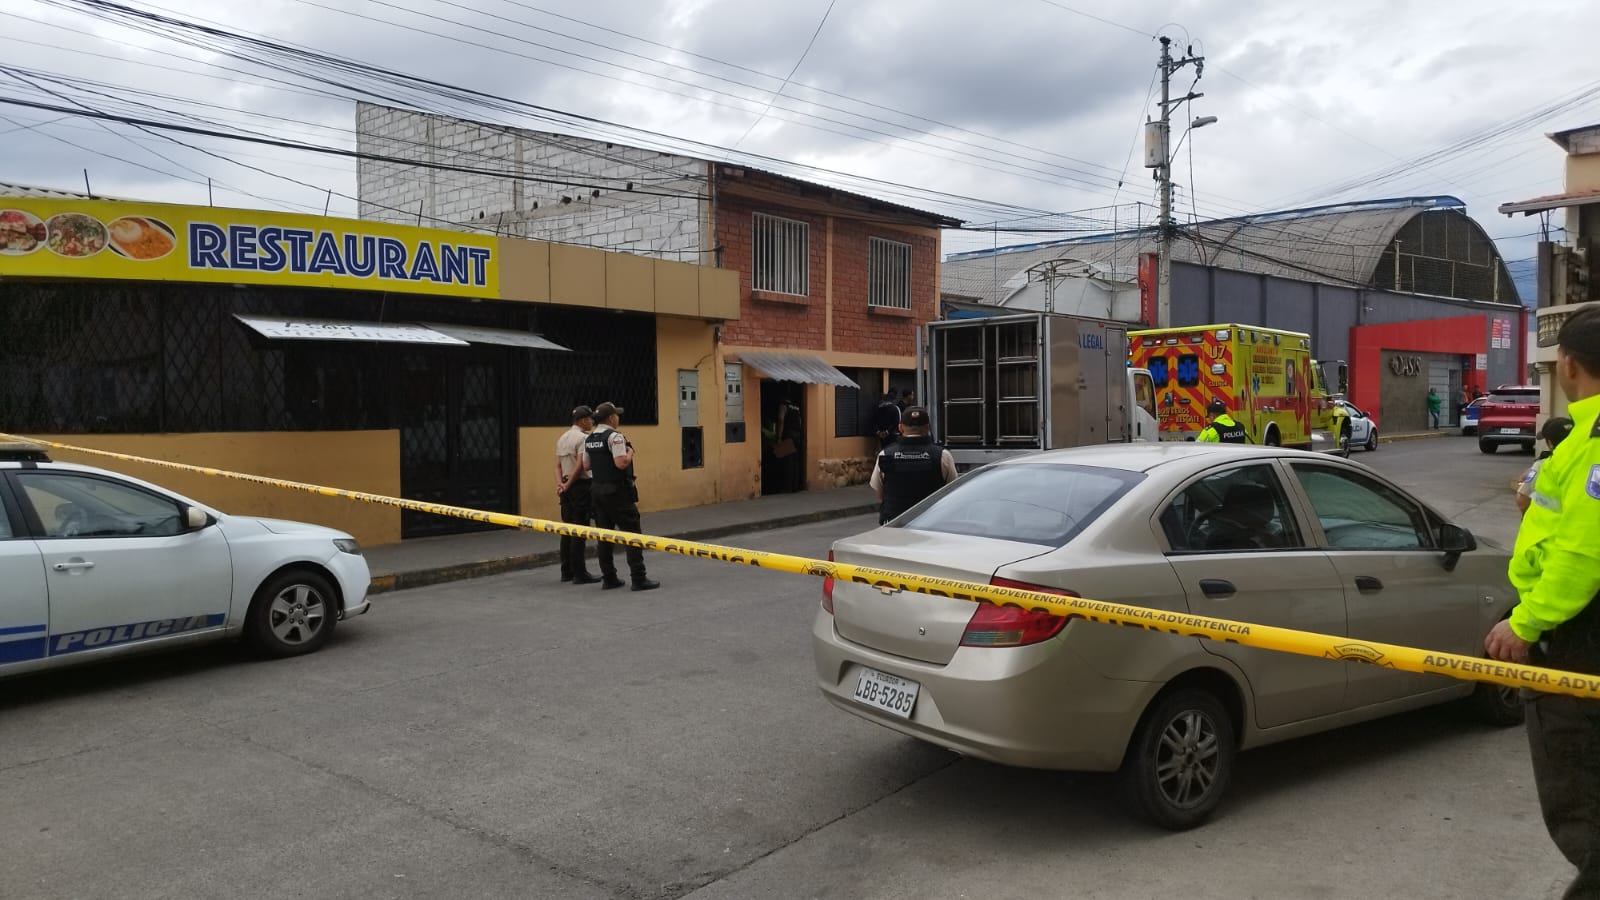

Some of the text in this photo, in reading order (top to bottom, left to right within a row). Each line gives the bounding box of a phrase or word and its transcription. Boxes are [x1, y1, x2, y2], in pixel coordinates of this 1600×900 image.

[188, 222, 492, 288] RESTAURANT
[1082, 334, 1104, 350] LEGAL
[1209, 344, 1227, 359] U7
[1223, 431, 1245, 439] POLICIA
[586, 441, 604, 449] POLICIA
[55, 617, 208, 651] POLICIA
[855, 677, 914, 713] LBB-5285
